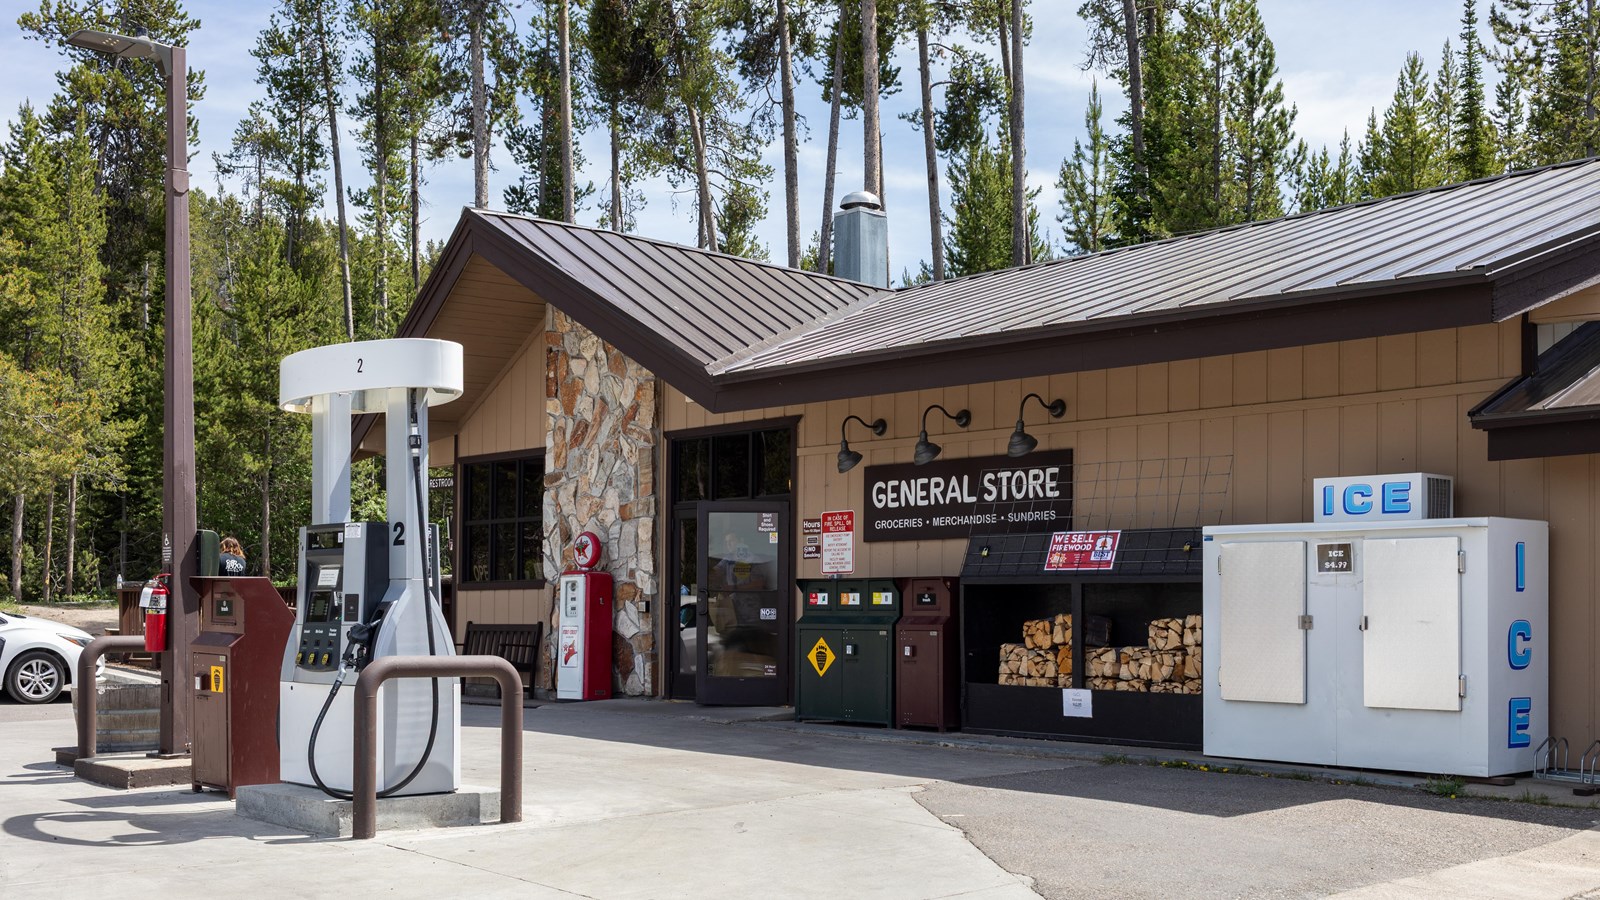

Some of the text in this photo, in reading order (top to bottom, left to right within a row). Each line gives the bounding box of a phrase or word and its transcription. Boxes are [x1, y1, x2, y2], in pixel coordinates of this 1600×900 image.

[357, 358, 363, 373] 2
[872, 467, 1060, 509] GENERAL STORE
[1323, 481, 1411, 516] ICE
[875, 510, 1056, 530] GROCERIES MERCHANDISE SUNDRIES
[393, 521, 405, 546] 2
[1054, 534, 1070, 543] WE
[1070, 534, 1094, 543] SELL
[1052, 543, 1092, 551] FIREWOOD
[1324, 561, 1347, 569] $4.99
[1508, 541, 1532, 748] ICE
